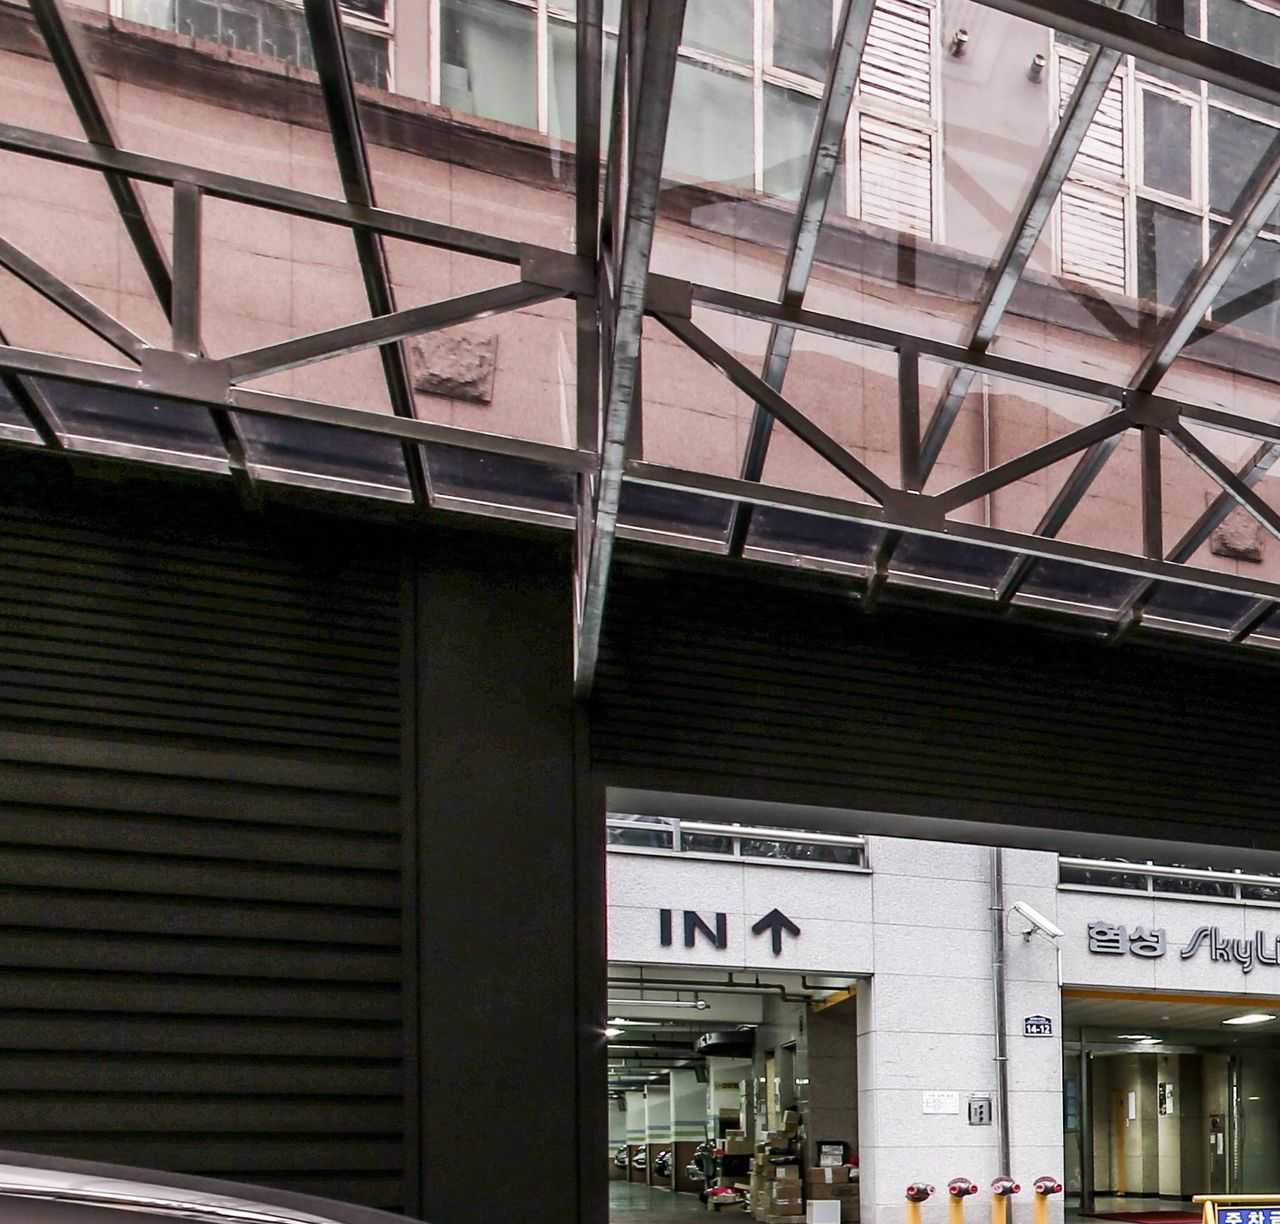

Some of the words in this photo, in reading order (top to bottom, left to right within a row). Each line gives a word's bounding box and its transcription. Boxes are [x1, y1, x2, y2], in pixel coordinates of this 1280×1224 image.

[660, 908, 727, 950] IN
[1088, 921, 1167, 958] 협성
[1026, 1024, 1051, 1034] 14-12
